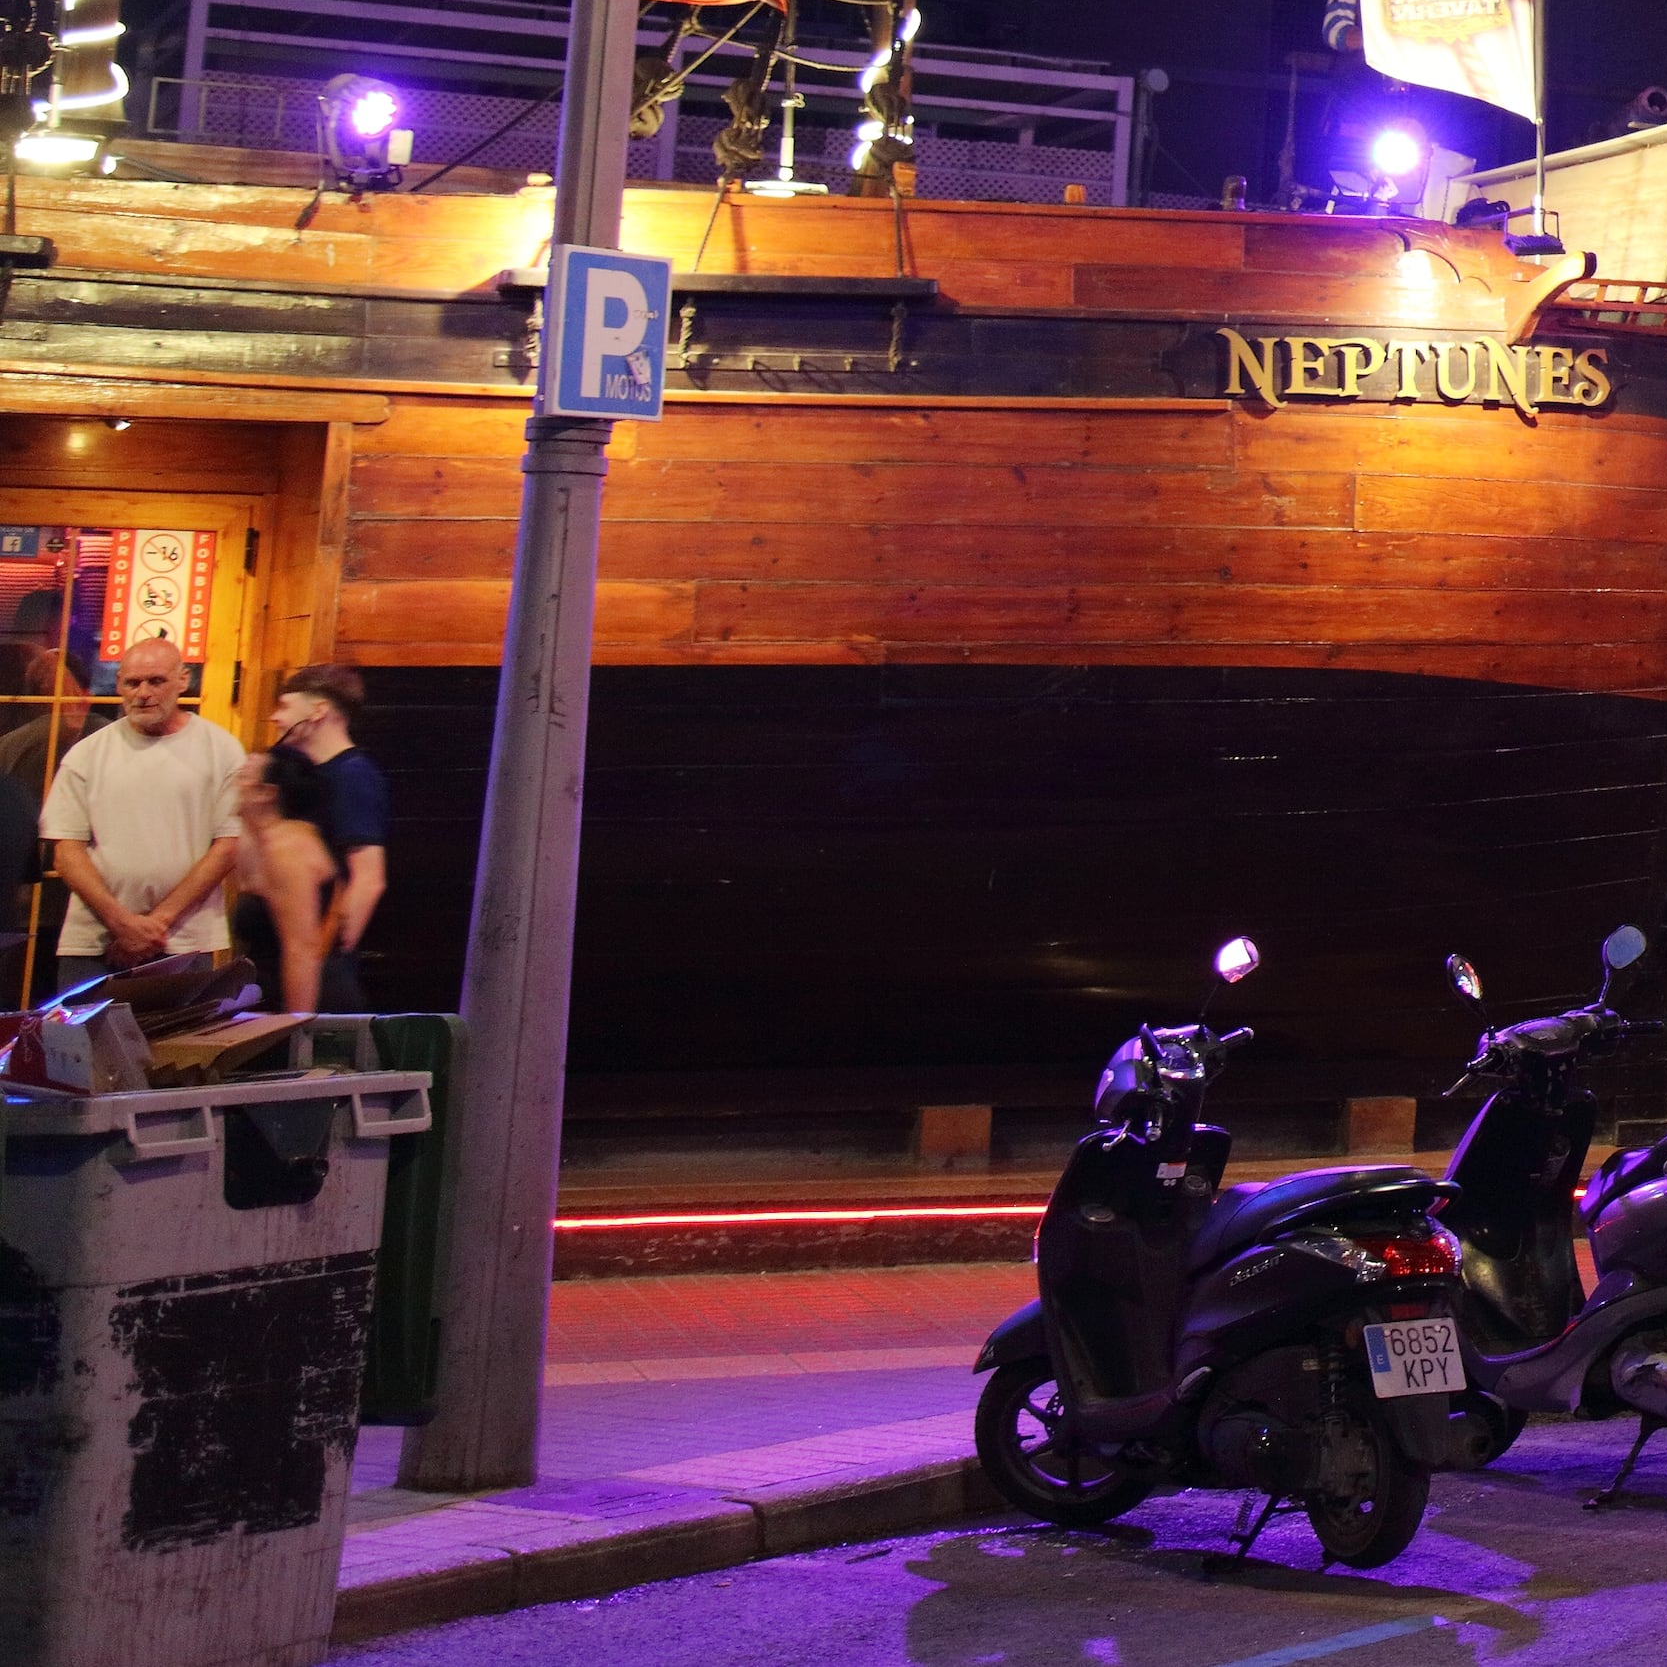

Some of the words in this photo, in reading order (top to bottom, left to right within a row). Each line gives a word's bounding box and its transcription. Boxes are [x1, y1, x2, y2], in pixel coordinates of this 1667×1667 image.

[581, 267, 648, 398] P
[1218, 327, 1611, 417] NEPTUNES
[107, 532, 130, 655] PROHIBIDO
[187, 534, 210, 657] FORBIDDEN
[1389, 1324, 1457, 1356] 6852
[1404, 1357, 1451, 1388] KPY
